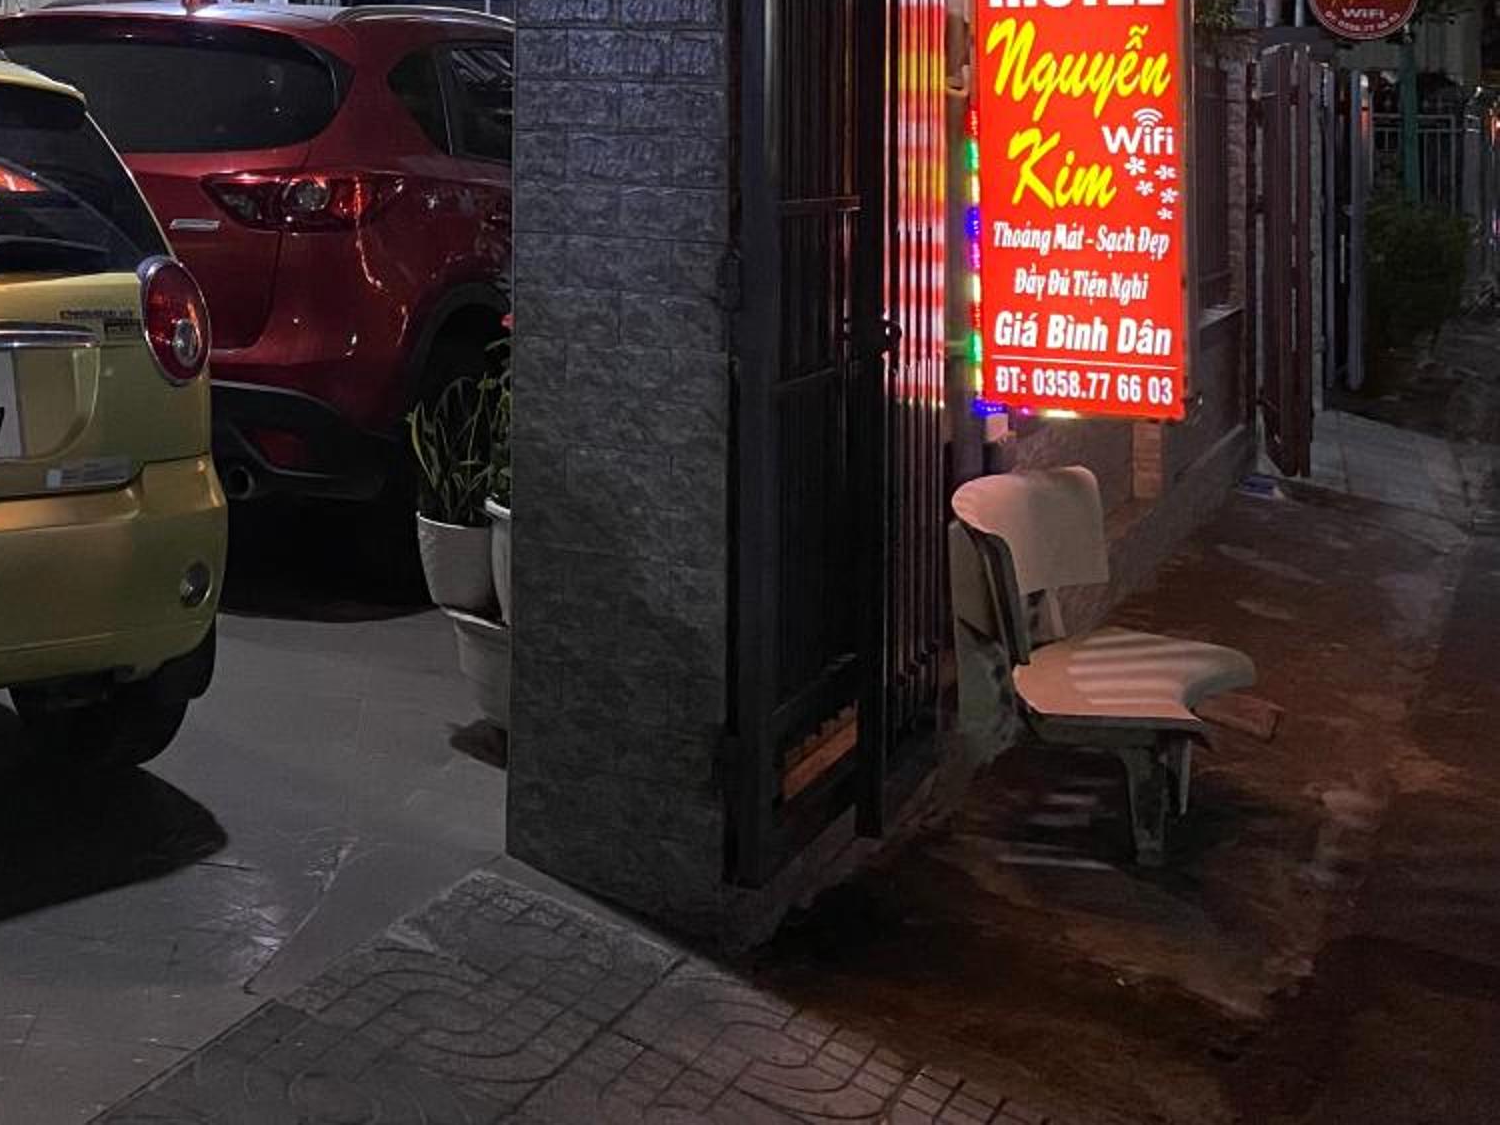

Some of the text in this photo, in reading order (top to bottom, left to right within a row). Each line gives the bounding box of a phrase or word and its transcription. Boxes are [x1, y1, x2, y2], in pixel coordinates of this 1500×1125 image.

[986, 18, 1171, 122] Nguyễn
[1007, 127, 1117, 209] Kim
[993, 220, 1051, 256] Thoáng
[1053, 222, 1084, 250] Mát
[1096, 225, 1135, 259] Sạch
[1138, 226, 1170, 261] Đẹp
[1014, 262, 1149, 306] Đầy Đủ Tiện Nghi
[995, 311, 1172, 355] Giá Bình Dân
[996, 366, 1172, 405] ĐT: 0358.77 66 03
